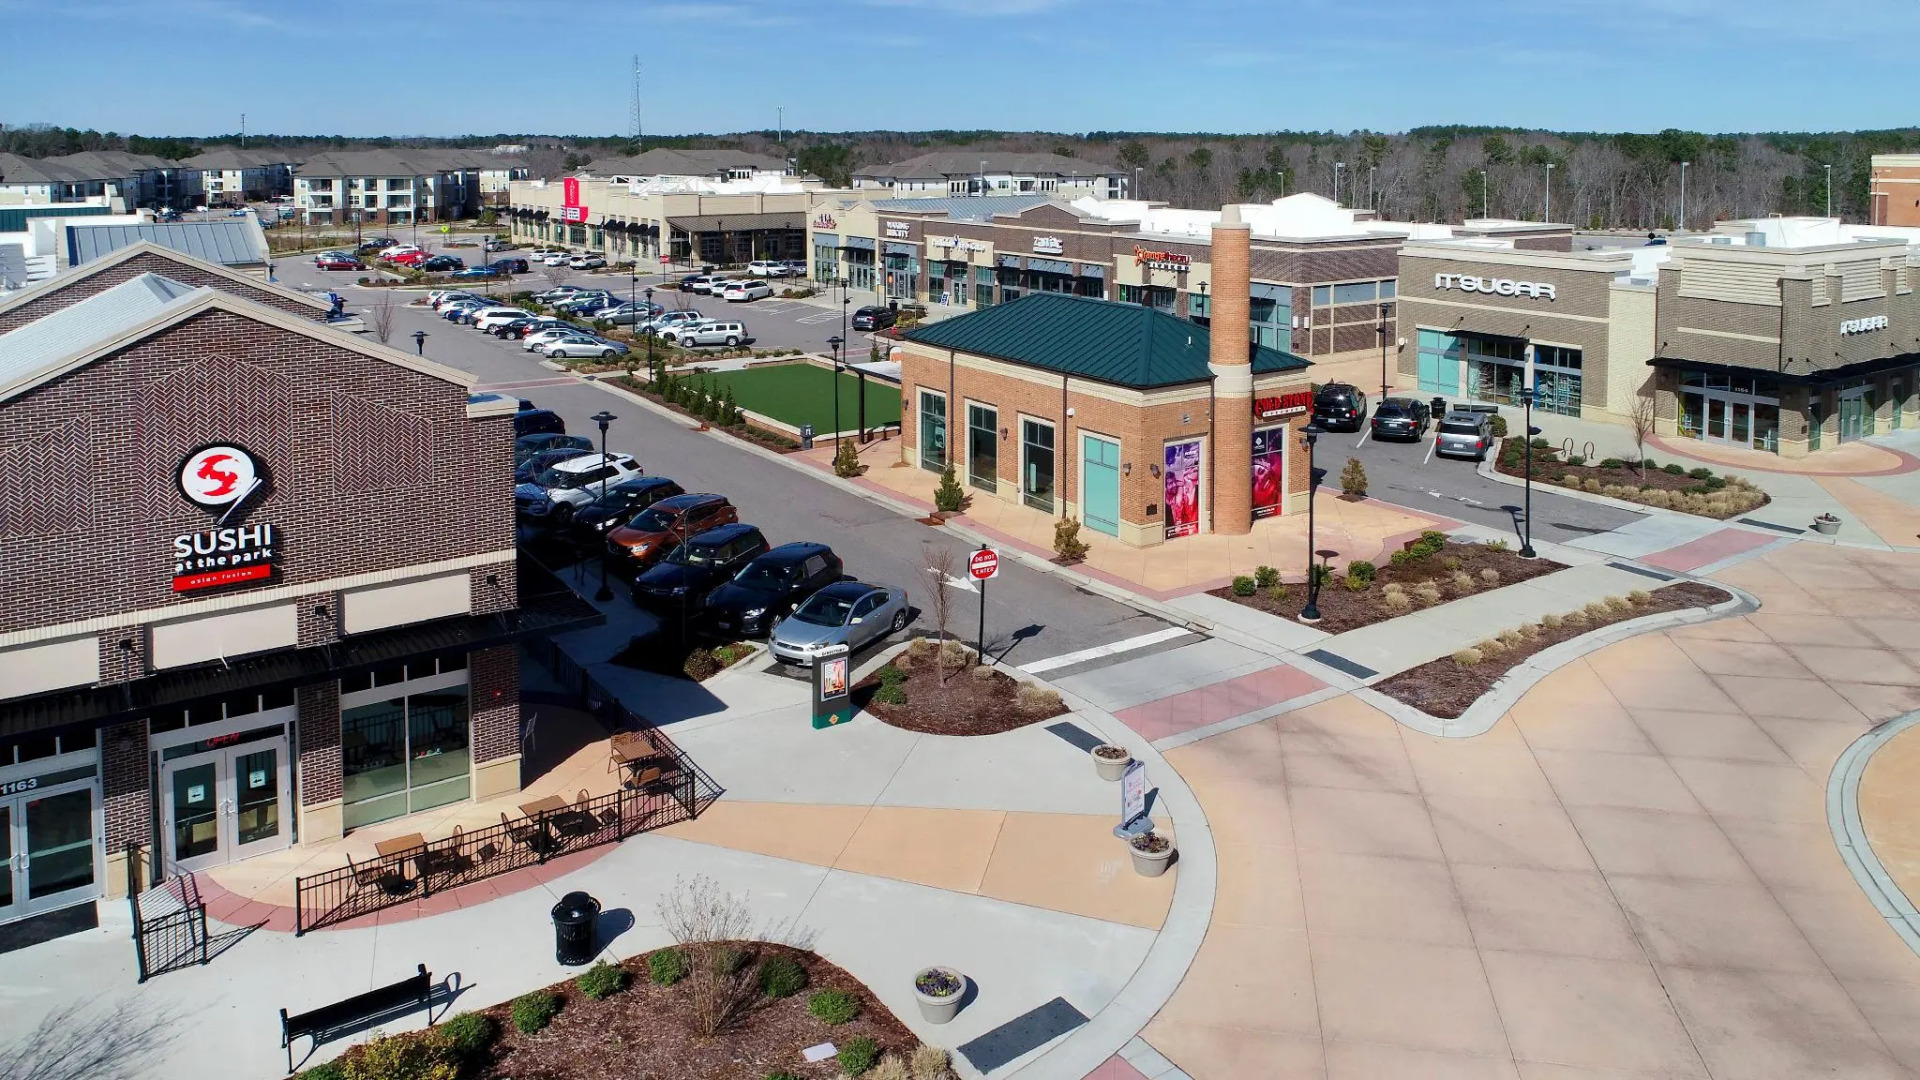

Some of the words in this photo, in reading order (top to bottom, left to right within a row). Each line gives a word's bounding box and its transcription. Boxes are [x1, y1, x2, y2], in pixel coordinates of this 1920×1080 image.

[1255, 397, 1281, 418] COLD
[1281, 391, 1314, 415] STONE
[173, 523, 271, 558] SUSHI
[175, 560, 193, 573] at
[197, 556, 227, 568] the
[231, 548, 272, 565] park
[984, 554, 995, 562] NOT
[190, 576, 217, 585] asian
[222, 571, 252, 579] fusion
[976, 567, 995, 575] ENTER
[206, 732, 240, 747] OPEN
[0, 778, 38, 795] 1163
